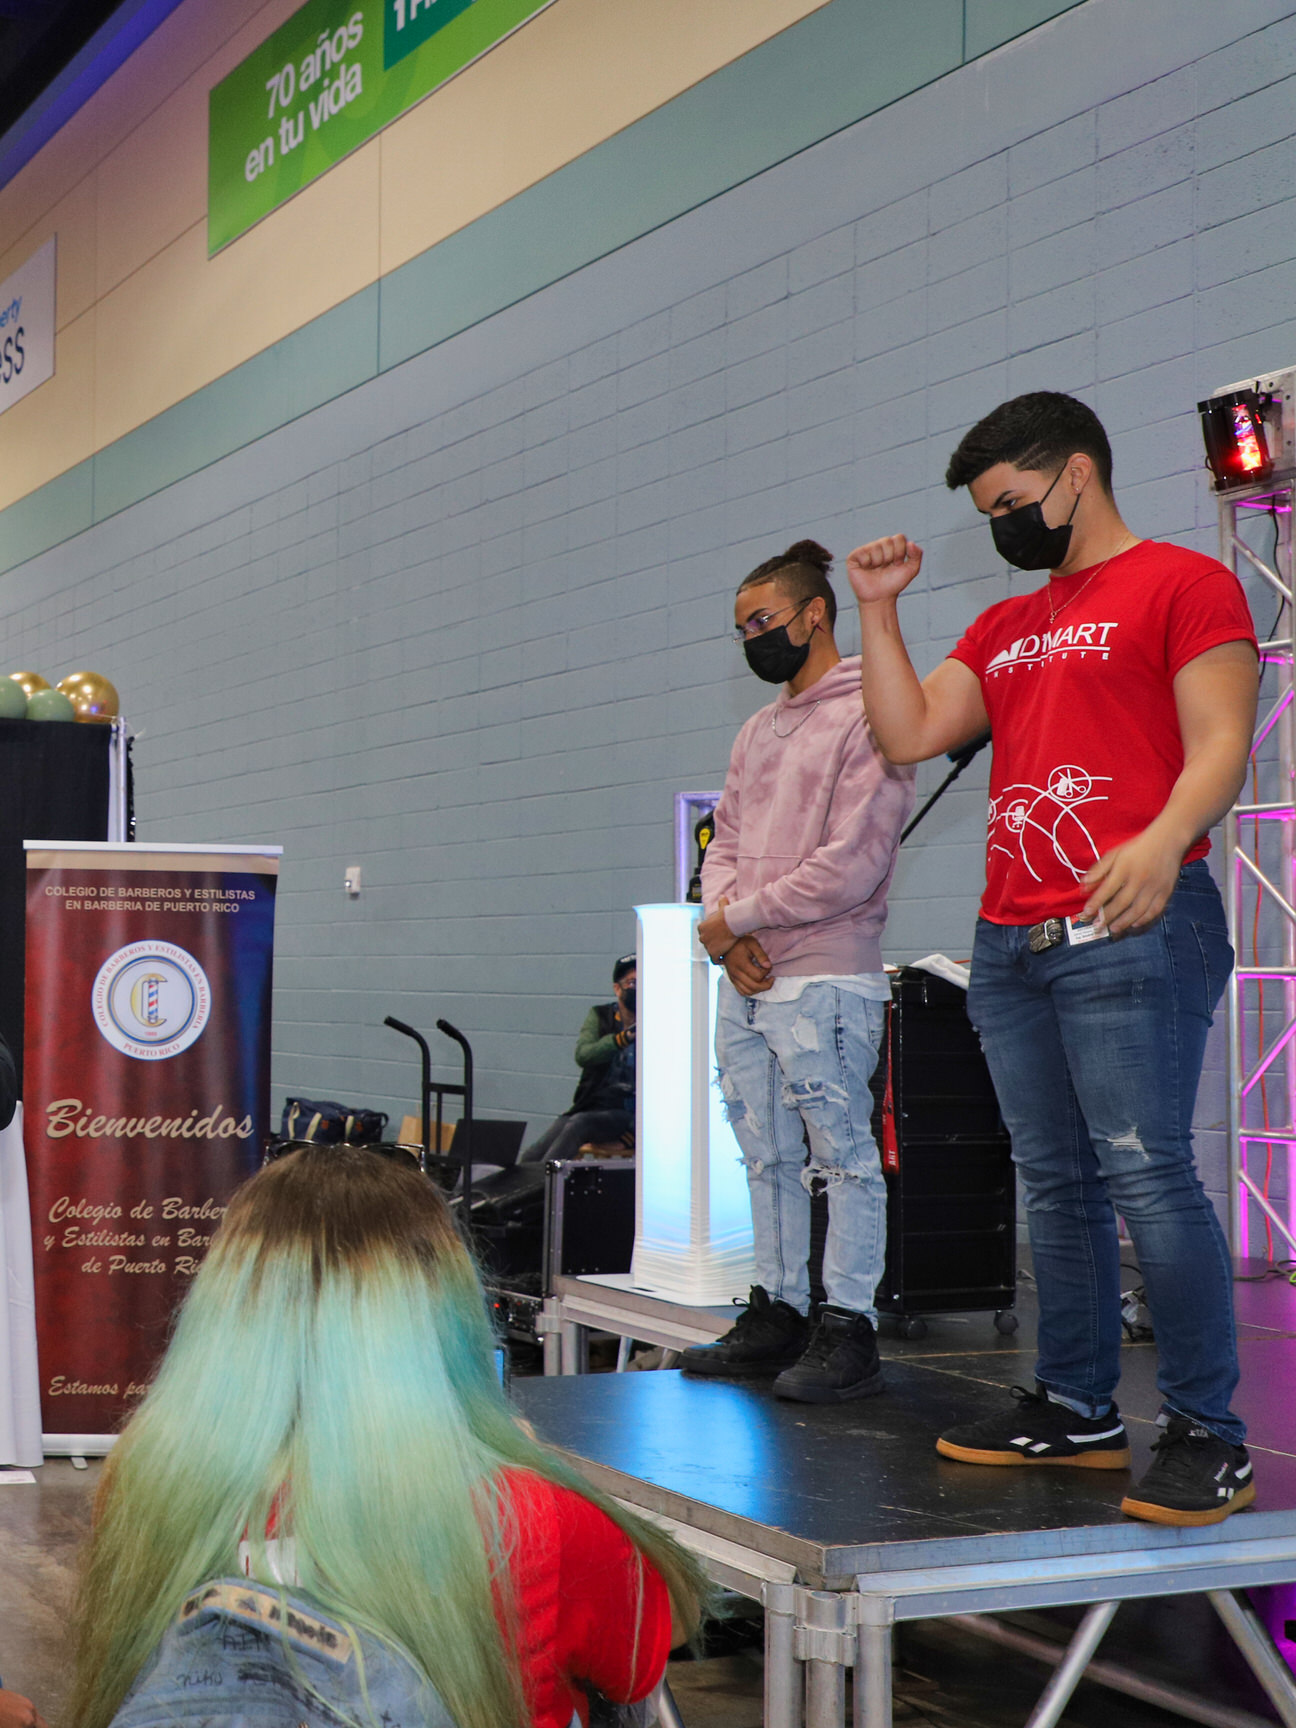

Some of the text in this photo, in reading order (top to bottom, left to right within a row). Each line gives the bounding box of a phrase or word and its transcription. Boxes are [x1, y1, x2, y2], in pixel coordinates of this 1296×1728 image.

[265, 63, 295, 119] 70
[299, 12, 364, 91] años
[244, 62, 363, 182] en tu vida
[45, 886, 256, 901] COLEGIO DE BARBEROS Y ESTILISTAS
[65, 900, 240, 913] EN BARBERIA DE PUERTO RICO
[105, 945, 146, 974] BARBEROS
[45, 1098, 255, 1140] Bienvenidos
[48, 1196, 229, 1225] Colegio de Barber
[43, 1233, 56, 1251] y
[62, 1226, 146, 1248] Estilistas
[151, 1234, 171, 1246] en
[81, 1256, 102, 1273] de
[108, 1255, 167, 1275] Puerto
[48, 1375, 147, 1399] Estamos pa
